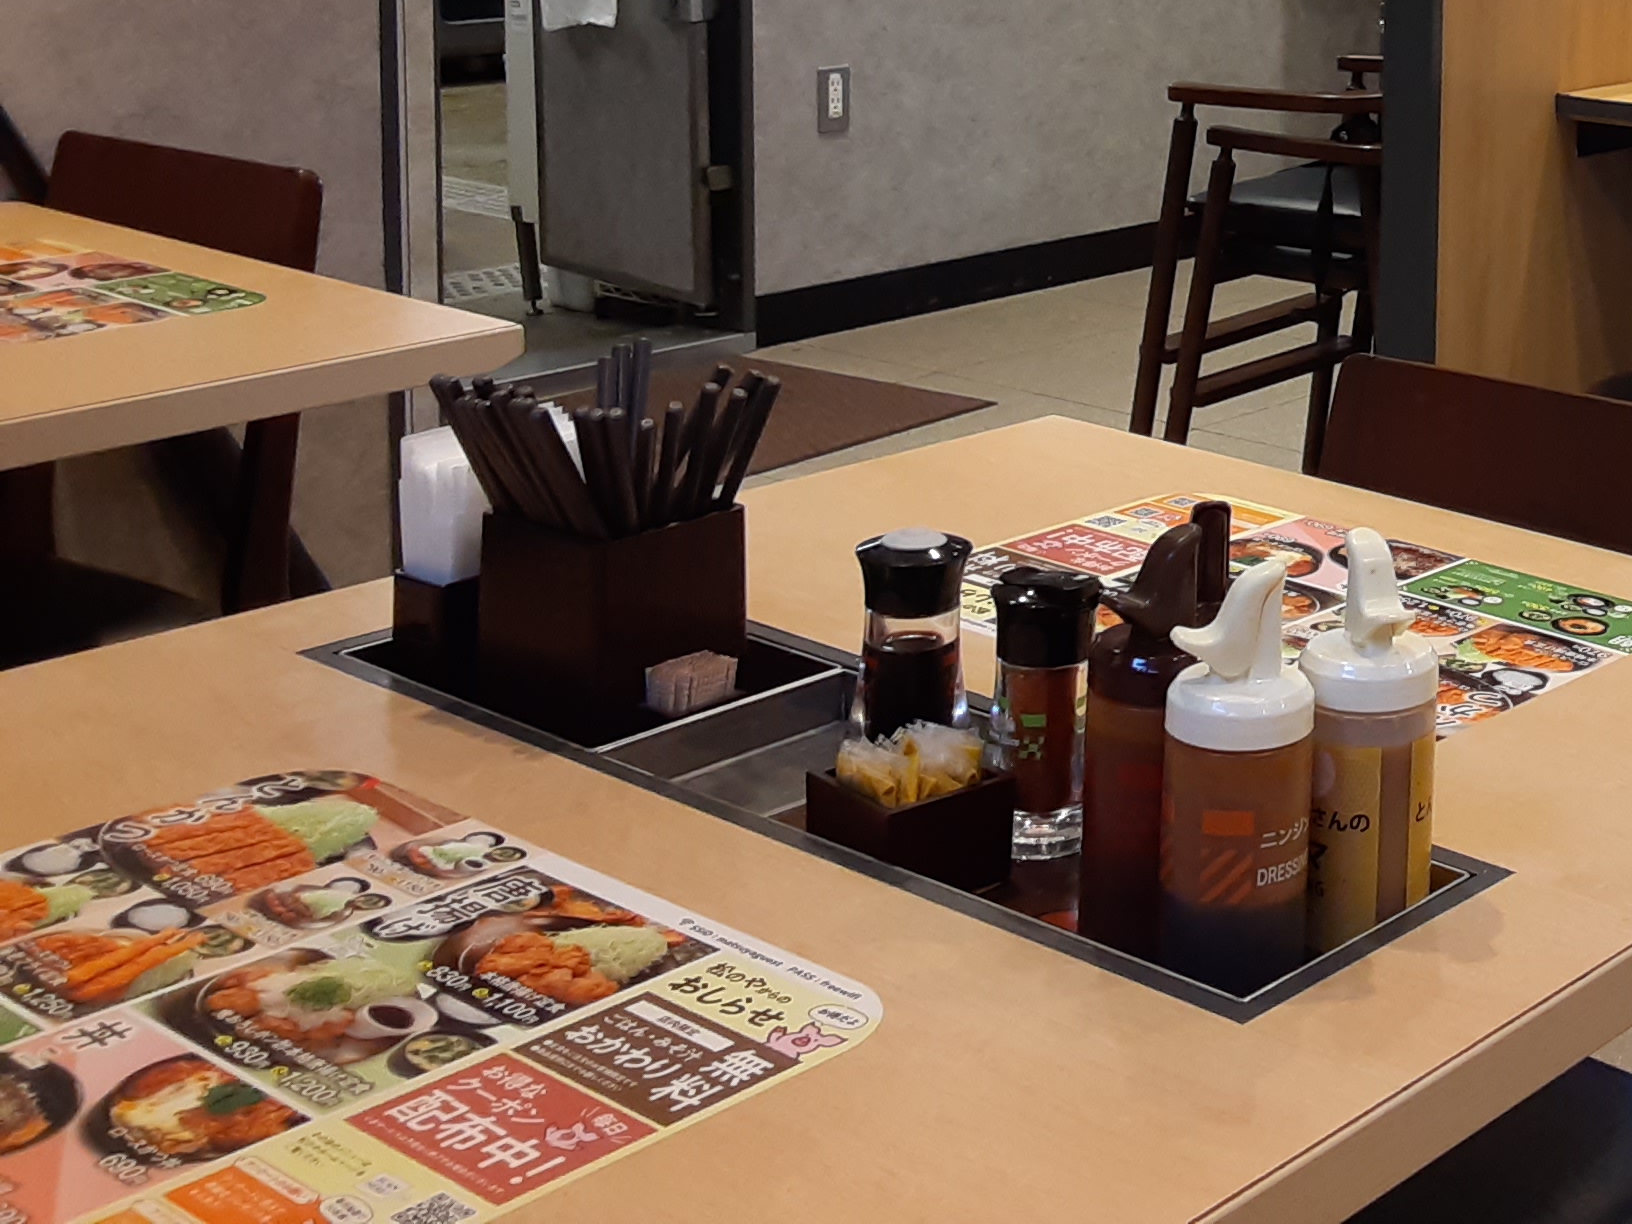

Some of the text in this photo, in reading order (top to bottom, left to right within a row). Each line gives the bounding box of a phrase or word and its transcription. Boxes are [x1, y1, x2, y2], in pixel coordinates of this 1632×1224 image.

[378, 877, 547, 936] 唐揚げ
[668, 976, 785, 1027] おしらせ
[565, 1024, 683, 1079] おかわり
[447, 1078, 545, 1123] クーポン
[649, 1049, 774, 1112] 無料
[383, 1088, 566, 1185] 配布中!
